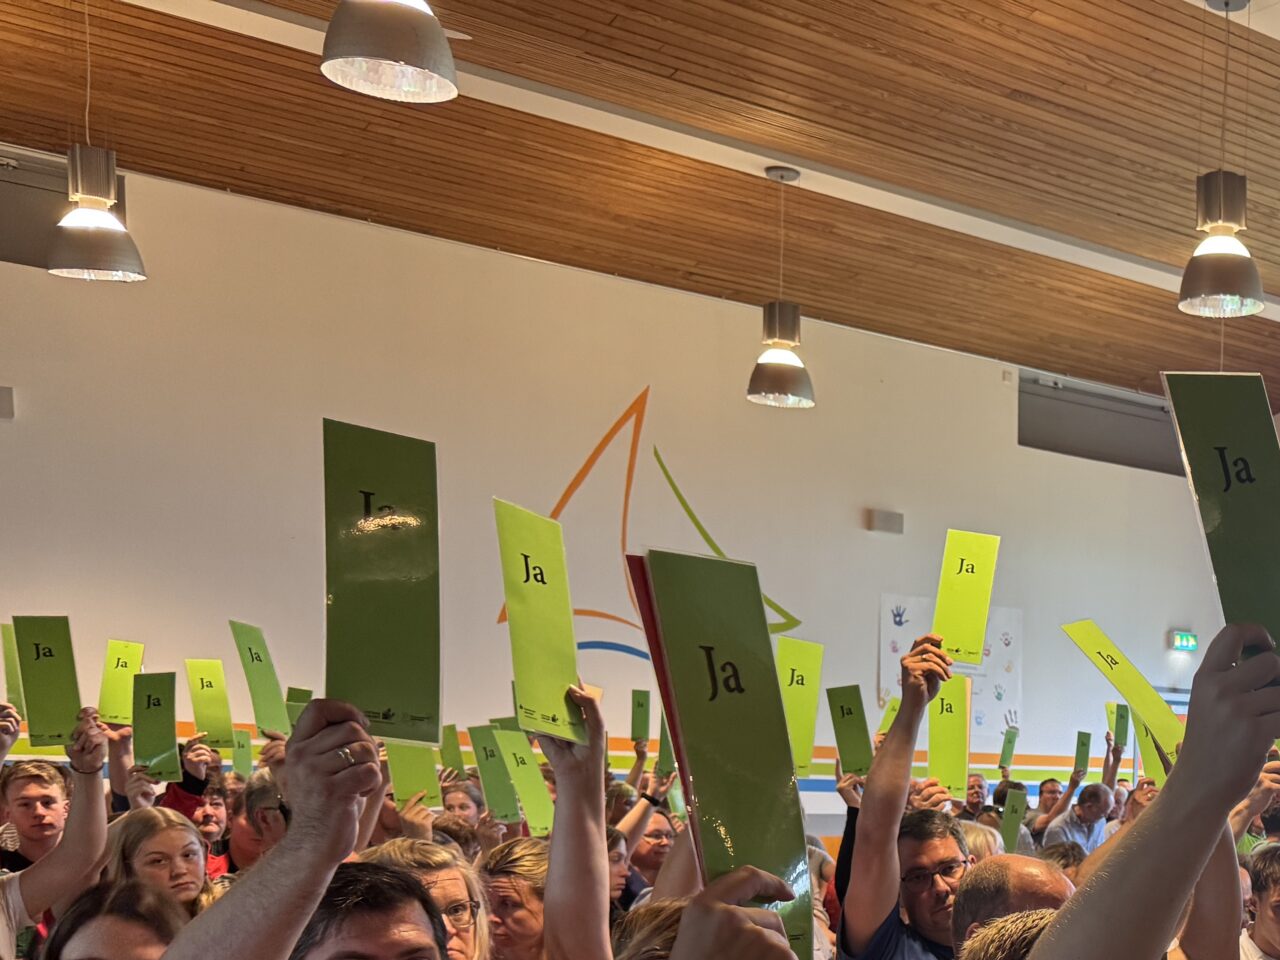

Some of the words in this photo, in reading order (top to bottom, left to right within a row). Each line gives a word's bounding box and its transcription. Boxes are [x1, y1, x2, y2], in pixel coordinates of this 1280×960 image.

[1213, 446, 1256, 492] Ja
[521, 553, 547, 585] Ja
[956, 558, 976, 575] Ja
[33, 643, 55, 661] Ja
[248, 647, 263, 663] Ja
[1096, 651, 1120, 670] Ja
[115, 657, 128, 669] Ja
[698, 645, 745, 702] Ja
[788, 668, 805, 687] Ja
[200, 677, 214, 690] Ja
[146, 694, 161, 710] Ja
[939, 697, 954, 715] Ja
[839, 705, 853, 719] Ja
[483, 746, 496, 761] Ja
[512, 752, 527, 767] Ja
